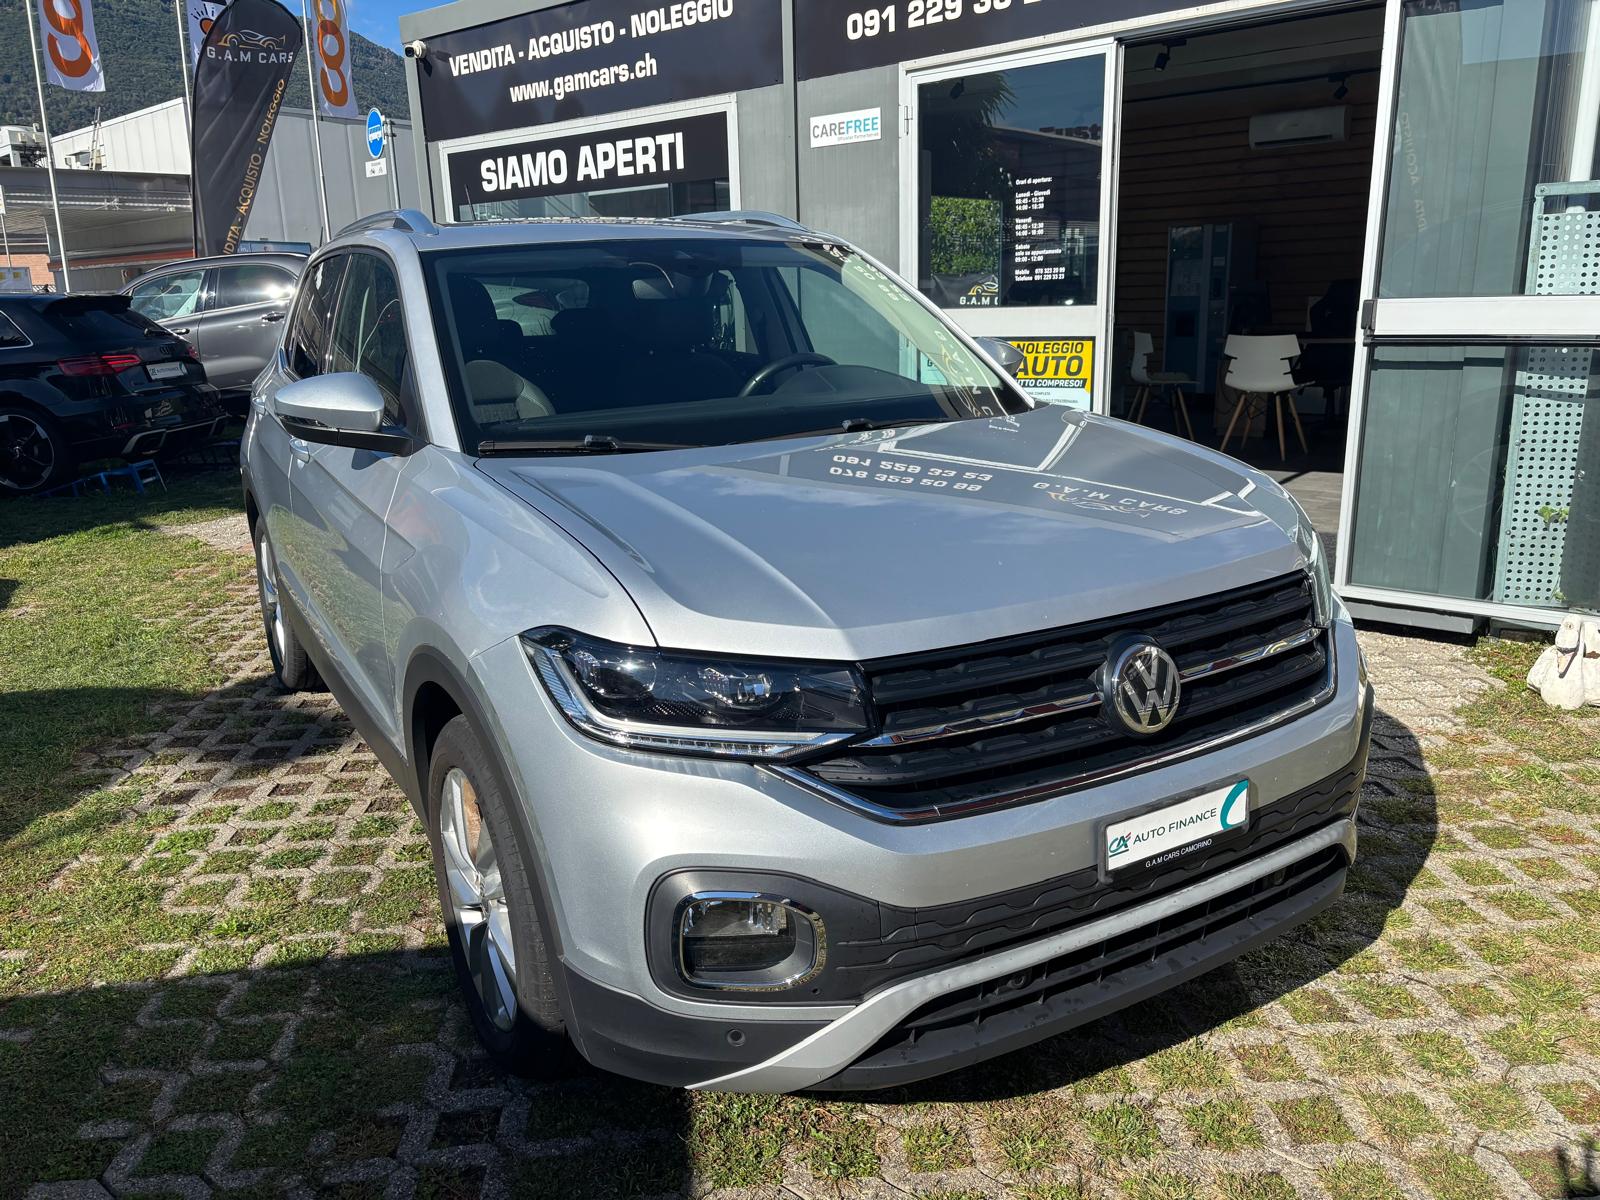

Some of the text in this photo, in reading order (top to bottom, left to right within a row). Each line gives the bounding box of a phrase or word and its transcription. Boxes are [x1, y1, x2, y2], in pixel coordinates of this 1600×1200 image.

[847, 5, 895, 40] 091
[908, 0, 963, 29] 229
[449, 44, 515, 76] VENDITA
[528, 21, 615, 61] ACQUISTO
[631, 0, 734, 38] NOLEGGIO
[206, 46, 294, 64] G.A.M CARS
[510, 53, 657, 103] www.gamcars.ch
[812, 116, 879, 139] CAREFREE
[236, 153, 262, 216] ACQUISTO
[257, 79, 285, 145] NOLEGGIO
[480, 132, 685, 193] SIAMO APERTI
[960, 296, 990, 305] G.A.M
[1017, 342, 1084, 354] NOLEGGIO
[1018, 356, 1084, 376] AUTO
[1036, 379, 1083, 387] COMPRESO!
[1133, 826, 1165, 845] AUTO
[1168, 808, 1217, 832] FINANCE
[1163, 851, 1180, 863] CARS
[1180, 839, 1213, 855] CAMORINO
